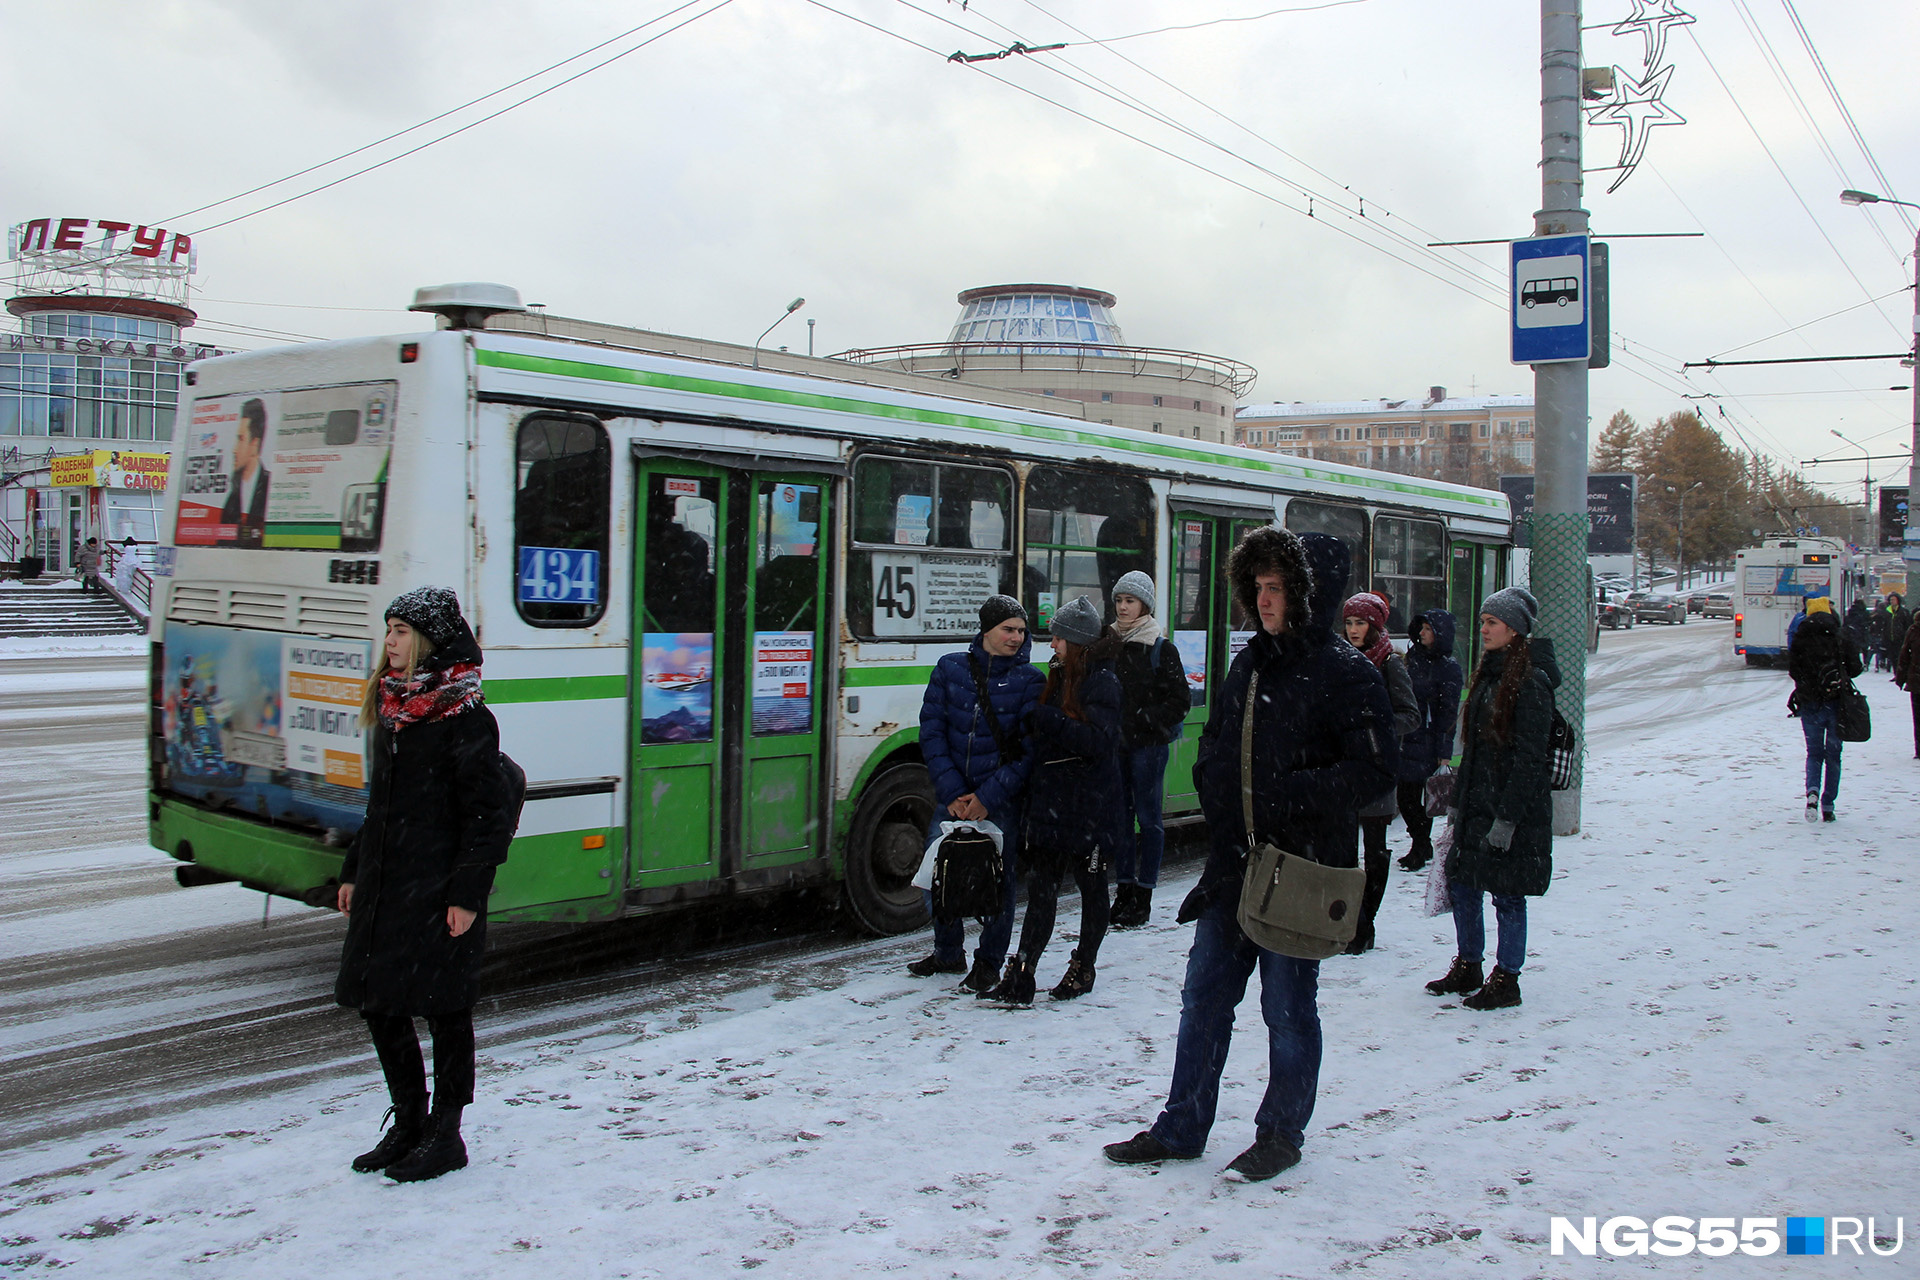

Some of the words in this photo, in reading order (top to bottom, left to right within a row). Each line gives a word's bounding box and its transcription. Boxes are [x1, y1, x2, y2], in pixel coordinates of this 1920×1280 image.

[51, 456, 94, 473] СВАДЕБНЫЙ
[121, 455, 170, 474] СВАДЕБНЫ
[56, 472, 89, 484] САЛОН
[668, 481, 697, 493] ВХОД
[1588, 493, 1608, 501] есяц
[520, 550, 596, 600] 434
[876, 566, 916, 619] 45
[957, 618, 982, 633] Амурс
